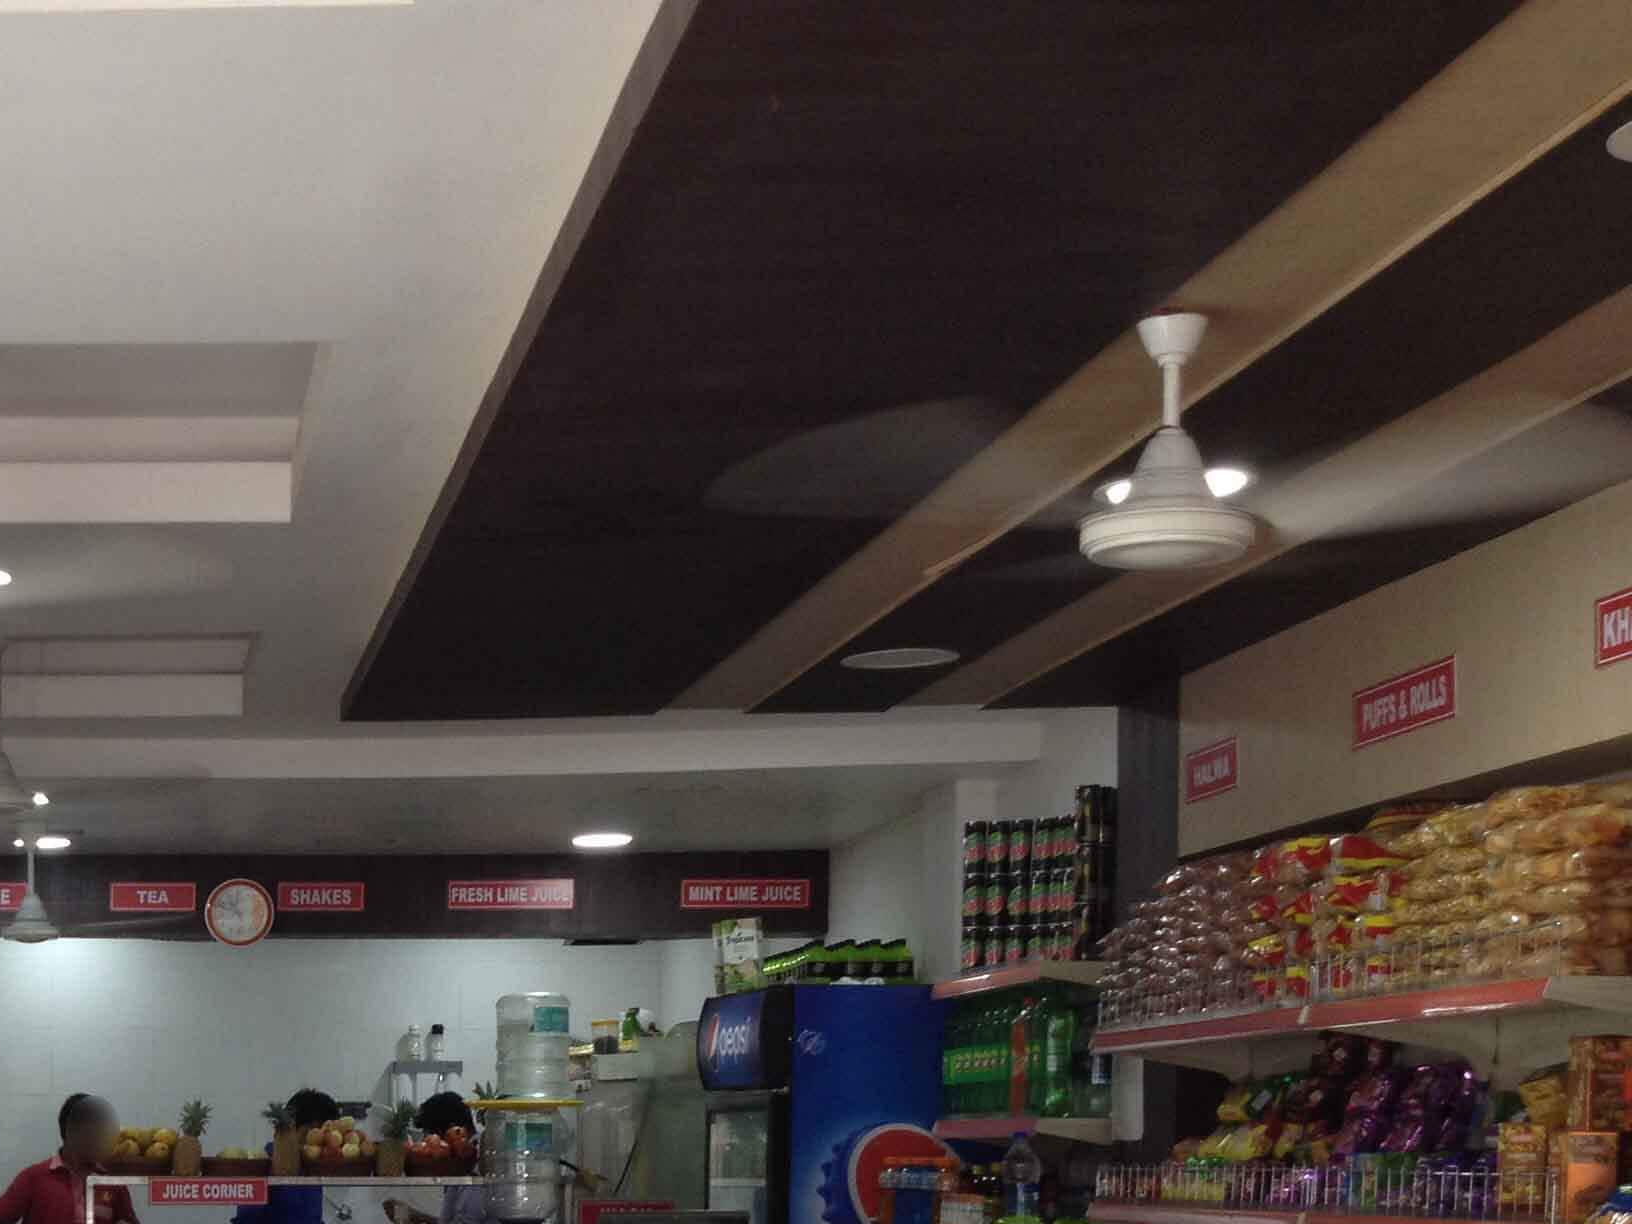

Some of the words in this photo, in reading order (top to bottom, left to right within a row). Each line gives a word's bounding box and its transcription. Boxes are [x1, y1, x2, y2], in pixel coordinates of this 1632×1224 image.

[1602, 604, 1632, 650] KH
[1361, 692, 1396, 733] PUFFS
[1397, 691, 1409, 719] &
[1409, 674, 1448, 714] ROLLS
[1192, 750, 1232, 788] HALWA
[136, 889, 170, 905] TEA
[290, 888, 353, 905] SHAKES
[451, 887, 493, 903] FRESH
[496, 887, 529, 903] LIME
[532, 886, 571, 902] JUICE
[688, 886, 722, 902] MINT
[726, 886, 759, 901] LIME
[761, 886, 802, 901] JUICE
[162, 1183, 200, 1199] JUICE
[202, 1183, 255, 1199] CORNER
